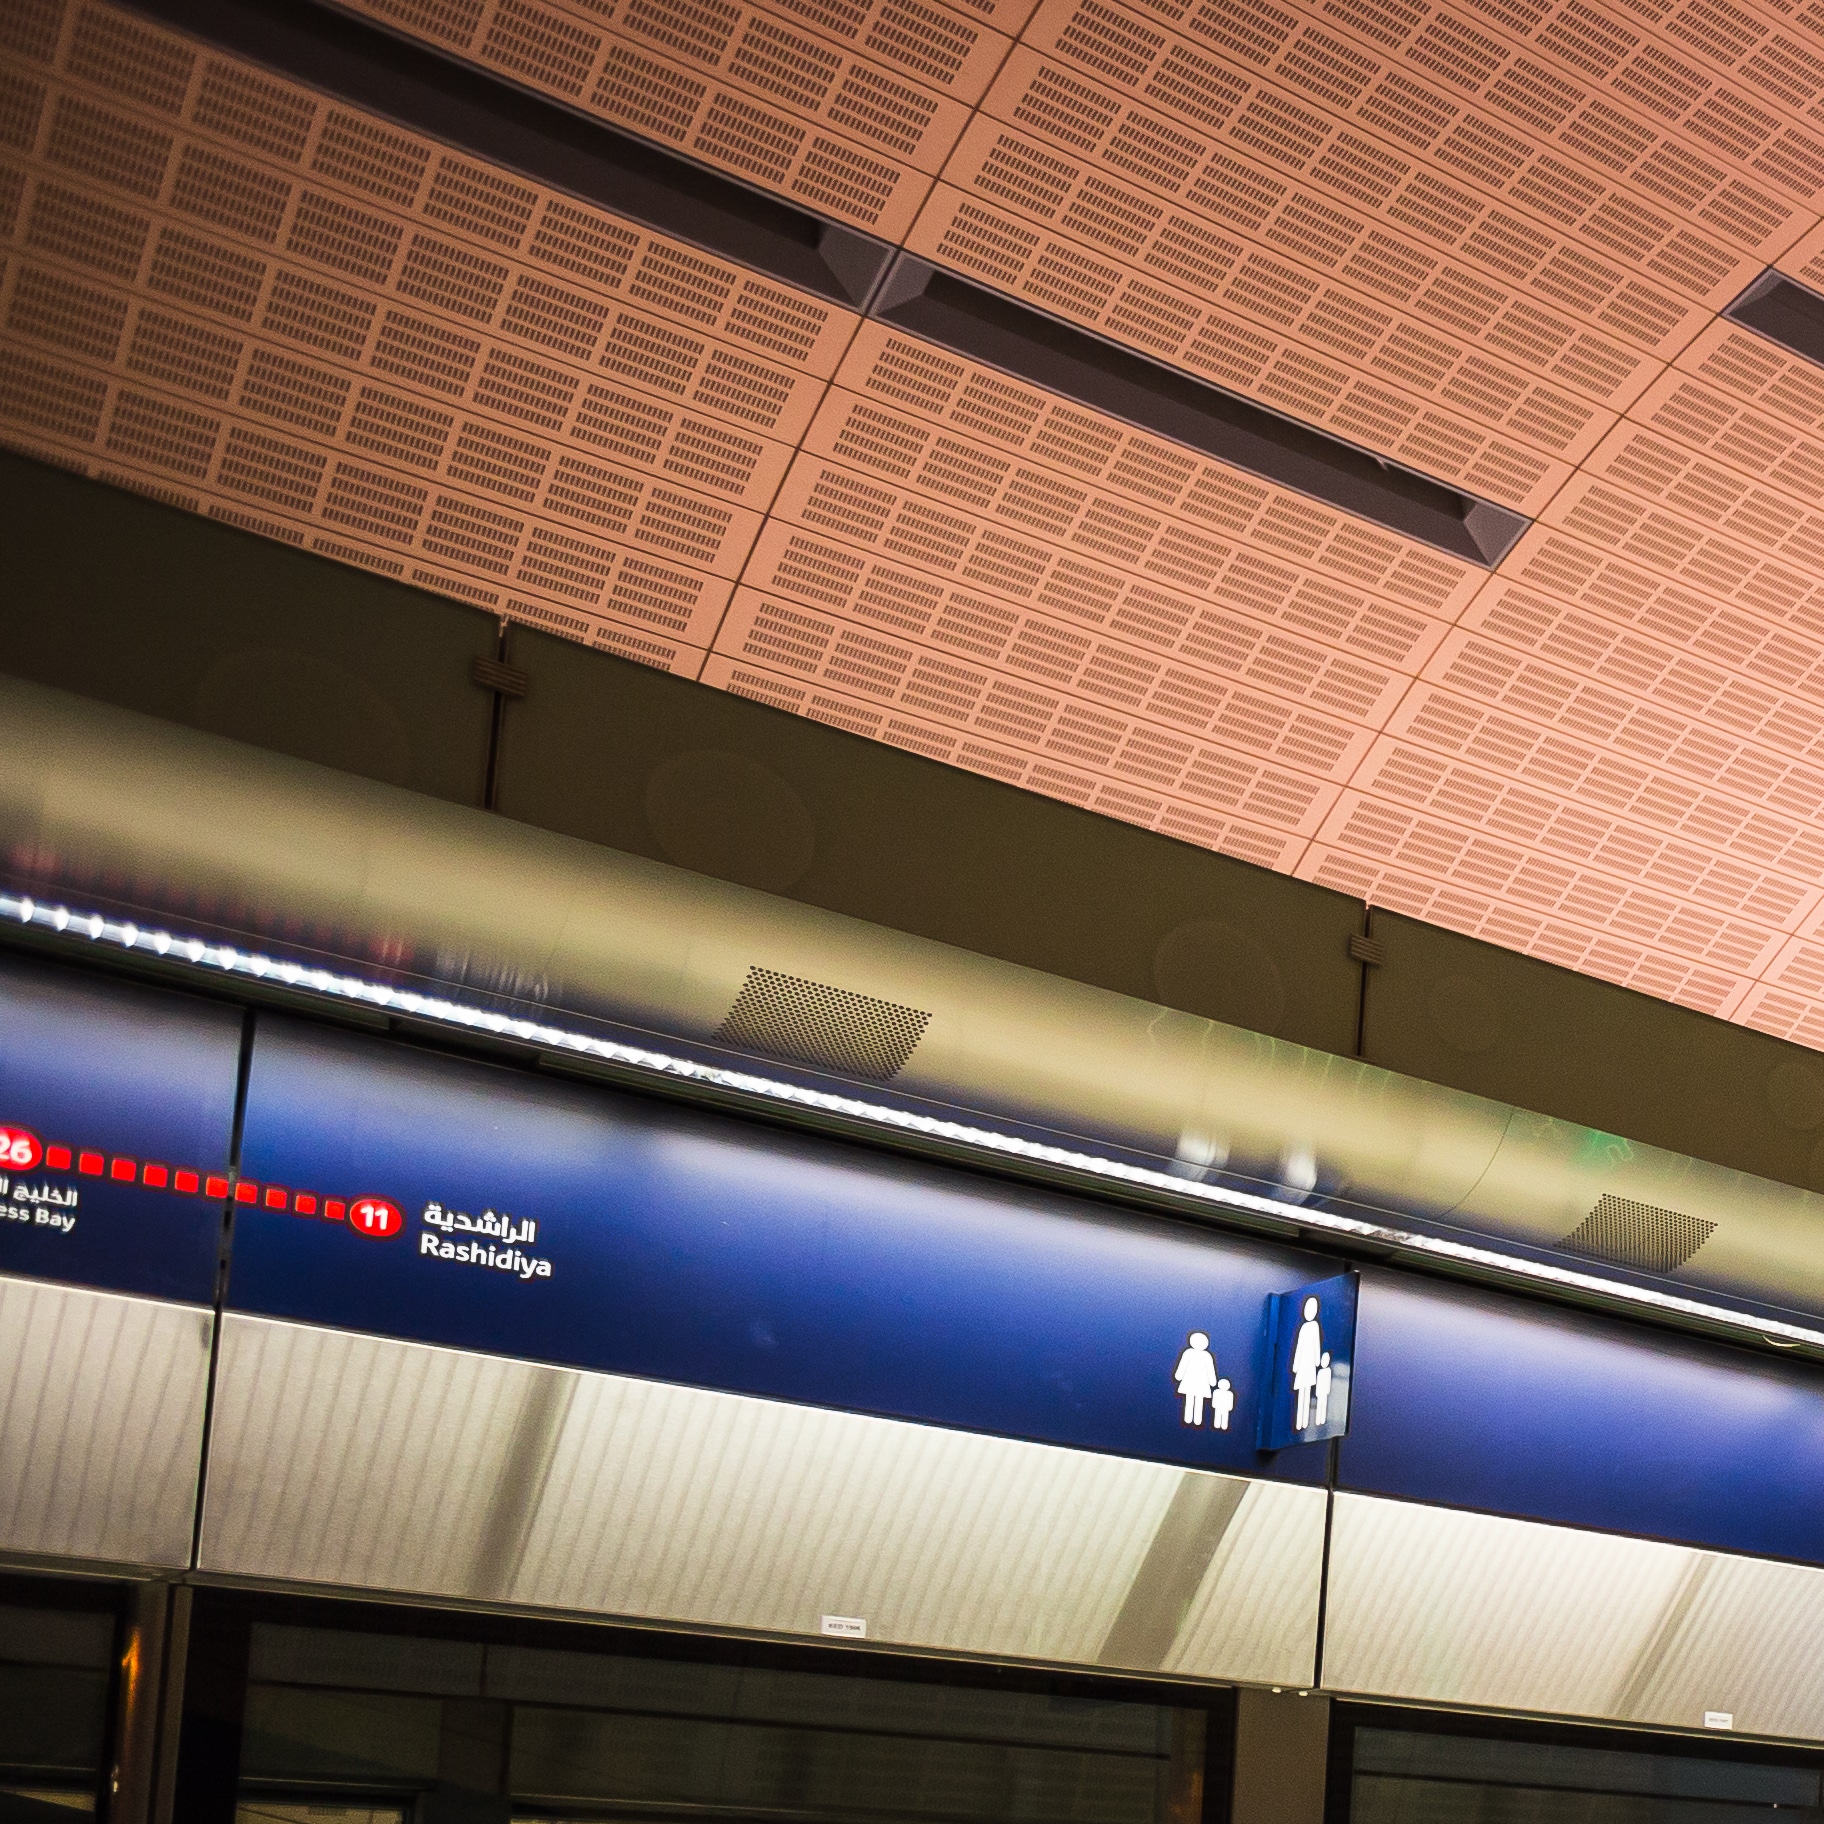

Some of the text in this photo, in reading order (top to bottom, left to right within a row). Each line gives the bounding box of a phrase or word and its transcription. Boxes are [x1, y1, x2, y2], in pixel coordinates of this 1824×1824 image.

[36, 1206, 76, 1234] Bay
[360, 1203, 389, 1231] 11
[424, 1202, 536, 1244] الراشدية
[420, 1232, 552, 1279] Rashidiya
